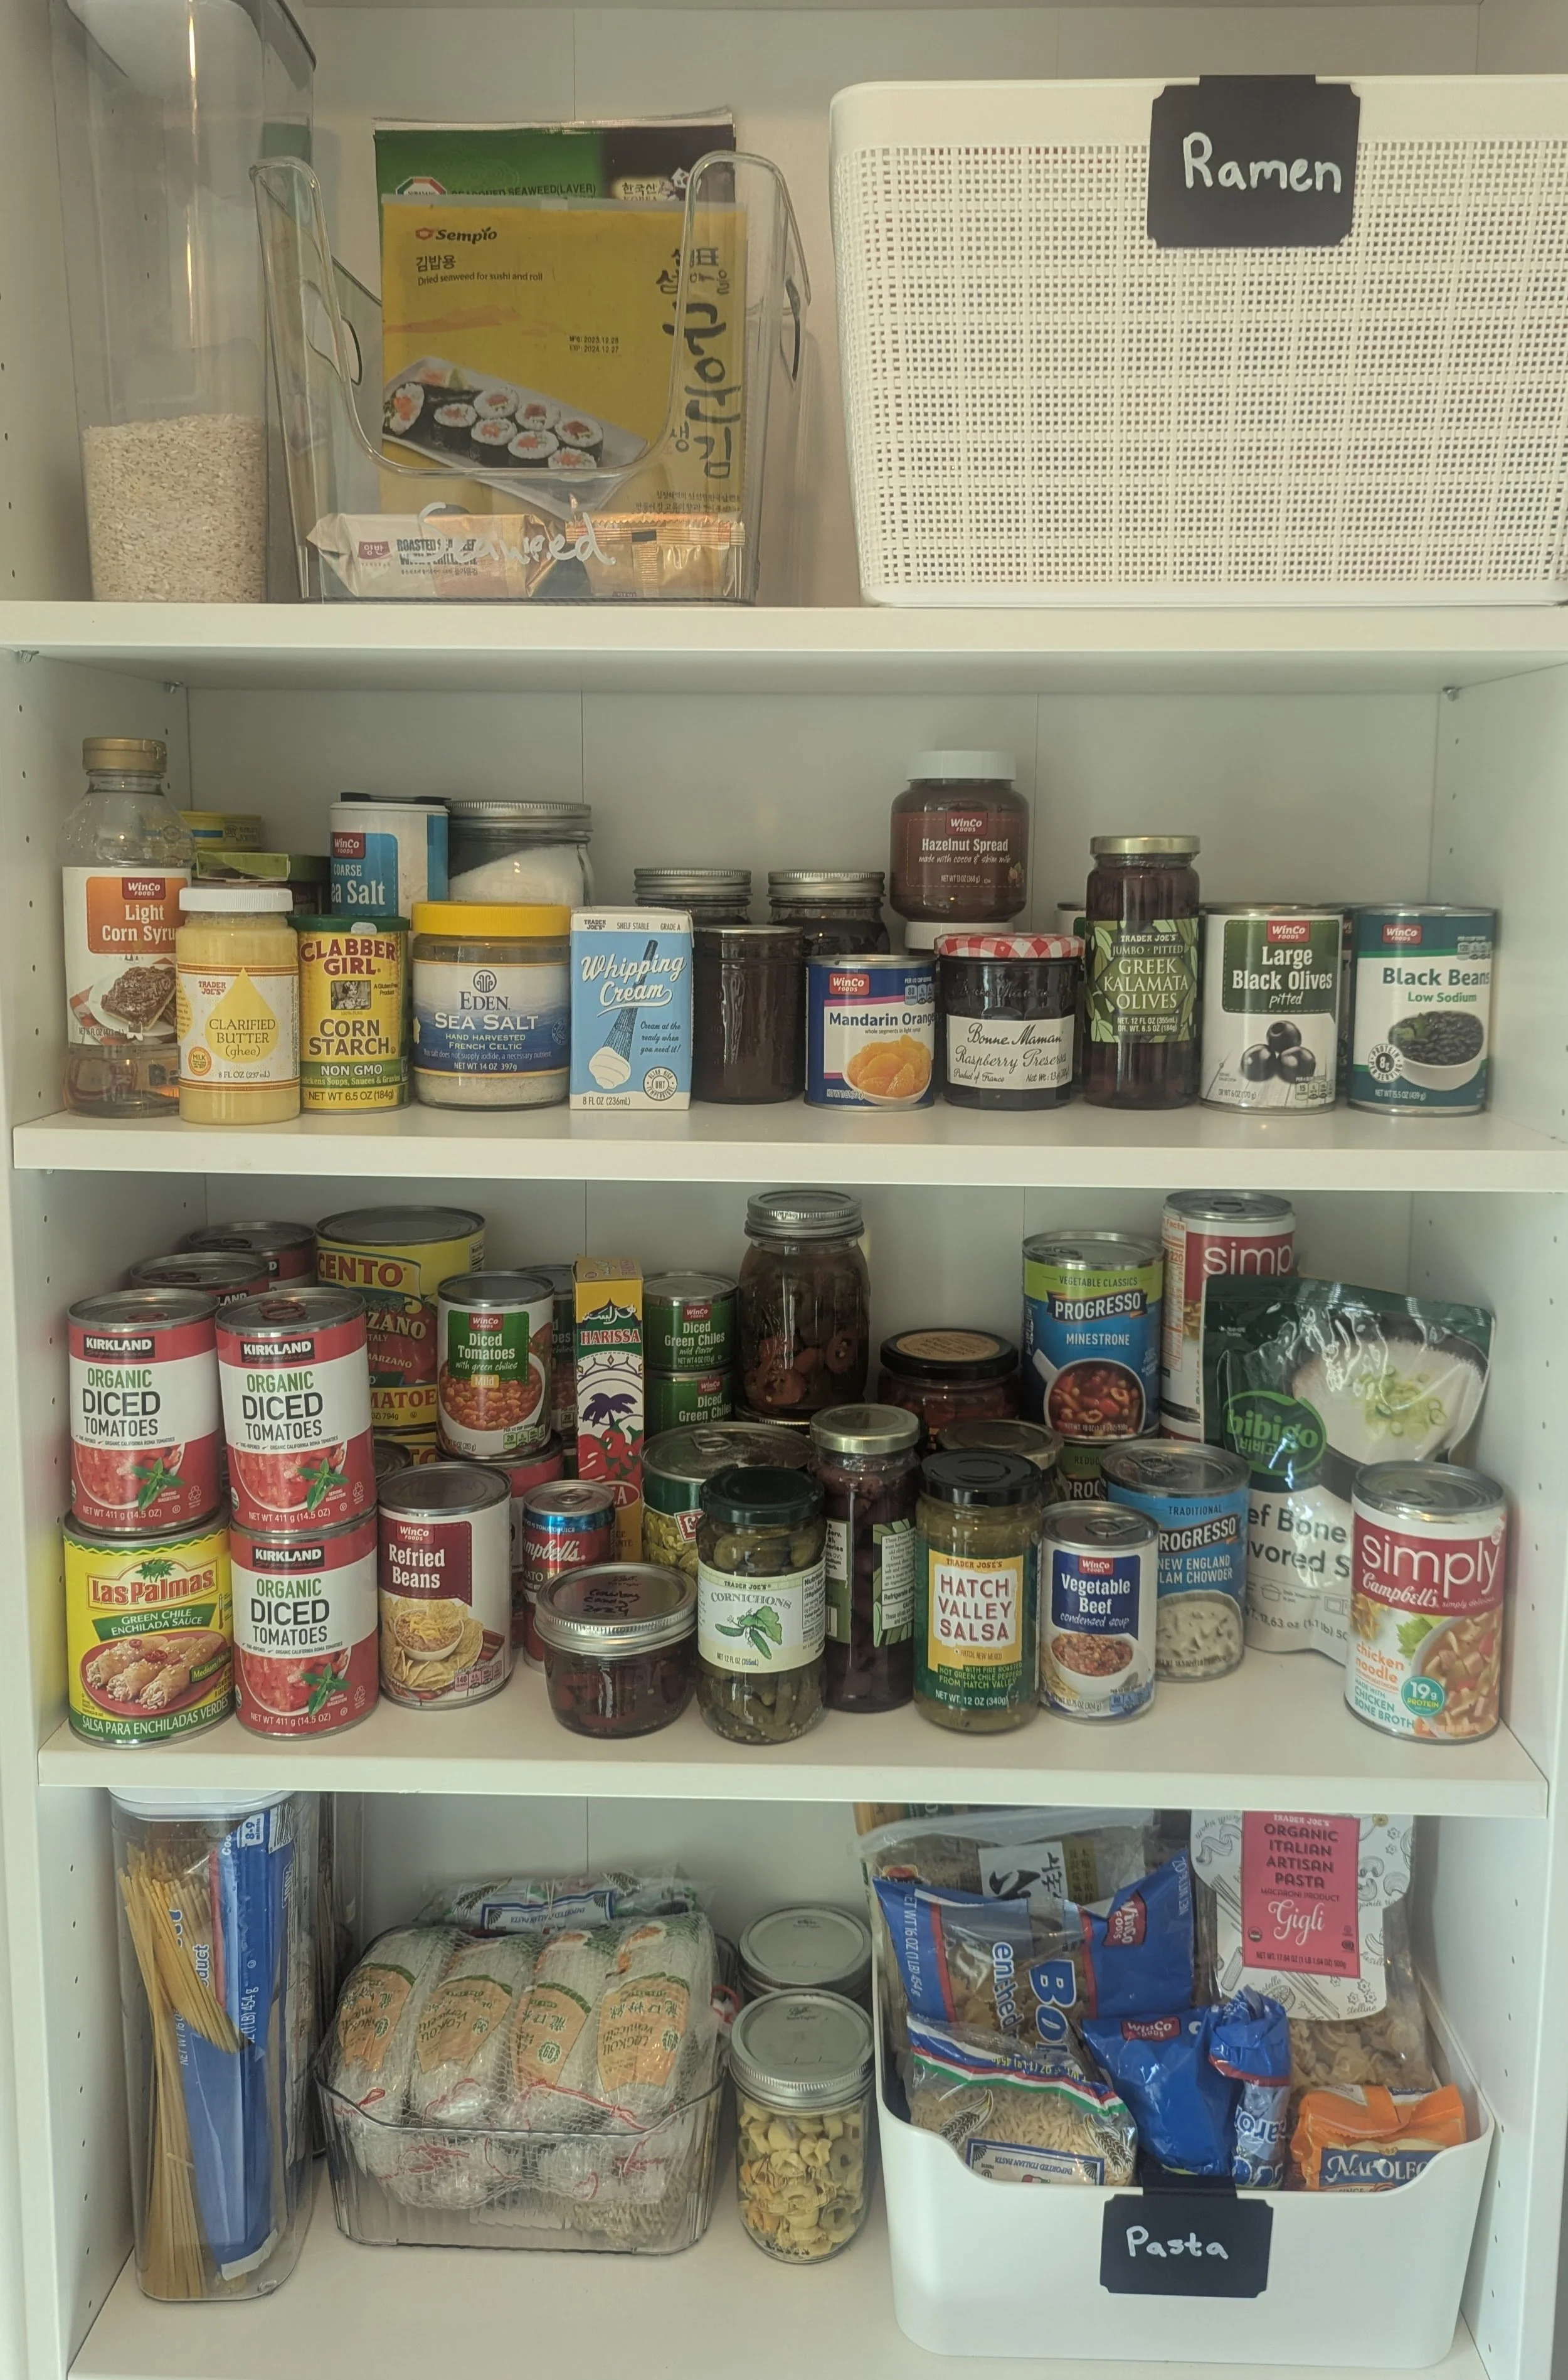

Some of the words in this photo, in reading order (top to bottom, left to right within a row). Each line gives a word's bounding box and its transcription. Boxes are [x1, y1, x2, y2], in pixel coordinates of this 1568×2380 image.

[1183, 132, 1342, 193] Ramen
[436, 227, 497, 244] Sempio
[416, 255, 457, 272] 김밥용
[418, 275, 438, 286] Dried
[441, 272, 475, 282] seaweed
[477, 272, 488, 280] for
[490, 272, 511, 280] sushi
[512, 272, 528, 280] and
[530, 272, 543, 281] roll
[950, 818, 982, 827] WinCo
[334, 838, 359, 848] WinCo
[922, 838, 970, 851] Hazelnut
[973, 839, 1009, 853] Spread
[334, 864, 362, 876] COARSE
[128, 882, 161, 891] WinCo
[331, 883, 342, 903] ea
[347, 879, 385, 905] Salt
[125, 905, 164, 924] Light
[102, 925, 137, 941] Corn
[144, 925, 176, 945] Syru
[1271, 925, 1305, 935] WinCo
[1385, 928, 1417, 937] WinCo
[301, 938, 396, 962] CLABBER
[1113, 946, 1145, 955] JUMBO
[1153, 945, 1183, 954] PITTED
[1261, 946, 1312, 969] Large
[324, 957, 376, 975] GIRL
[581, 954, 687, 984] Whipping
[1118, 958, 1177, 975] GREEK
[198, 980, 226, 989] TRADER
[833, 977, 864, 987] WinCo
[1104, 975, 1189, 992] KALAMATA
[1232, 970, 1282, 990] Black
[1288, 970, 1332, 991] Olives
[1382, 967, 1441, 986] Black
[1448, 969, 1490, 986] Beans
[458, 991, 509, 1011] EDEN
[599, 982, 672, 1009] Cream
[1116, 993, 1177, 1009] OLIVES
[1269, 991, 1304, 1009] pitted
[1407, 992, 1433, 1002] Low
[1436, 992, 1477, 1002] Sodium
[209, 1019, 276, 1030] CLARIFIED
[319, 1019, 379, 1038] CORN
[435, 1012, 475, 1030] SEA
[483, 1014, 539, 1030] SALT
[829, 1012, 898, 1027] Mandarin
[902, 1012, 935, 1028] Orange
[216, 1033, 270, 1043] BUTTER
[967, 1022, 1009, 1045] Bonne
[1012, 1024, 1062, 1045] Maman
[225, 1044, 261, 1059] (ghee)
[309, 1037, 389, 1056] STARCH
[449, 1042, 485, 1050] FRENCH
[501, 1063, 517, 1071] 397g
[955, 1045, 1019, 1074] Raspberry
[320, 1065, 351, 1076] NON
[354, 1064, 383, 1076] GMO
[309, 1092, 325, 1100] NET
[328, 1092, 343, 1101] WT
[359, 1092, 373, 1100] OZ
[1203, 1241, 1292, 1276] simp
[319, 1254, 403, 1287] CENTO
[1059, 1275, 1101, 1288] VEGETABLE
[1103, 1277, 1138, 1287] CLASSICS
[1055, 1292, 1141, 1320] PROGRESSO
[683, 1321, 711, 1334] Diced
[86, 1337, 152, 1351] KIRKLAND
[469, 1333, 502, 1346] Diced
[580, 1329, 641, 1346] HARISSA
[664, 1335, 694, 1347] Green
[698, 1332, 725, 1346] Chiles
[1066, 1333, 1130, 1346] MINESTRONE
[243, 1341, 312, 1356] KIRKLAND
[458, 1344, 515, 1360] Tomatoes
[472, 1362, 492, 1373] green
[494, 1361, 518, 1371] chilies
[88, 1367, 152, 1388] ORGANIC
[246, 1371, 314, 1393] ORGANIC
[474, 1376, 494, 1386] Mild
[82, 1387, 161, 1417] DICED
[242, 1391, 323, 1421] DICED
[697, 1393, 722, 1408] Diced
[679, 1410, 708, 1422] Green
[83, 1416, 158, 1437] TOMATOES
[245, 1419, 322, 1442] TOMATOES
[1226, 1410, 1318, 1450] bibigo
[1169, 1504, 1222, 1516] TRADITIONAL
[400, 1526, 429, 1537] WinCo
[1160, 1517, 1236, 1551] ROGRESSO
[1277, 1507, 1346, 1544] Bone
[255, 1548, 322, 1562] KIRKLAND
[389, 1543, 445, 1567] Refried
[946, 1558, 974, 1568] TRADER
[1186, 1554, 1230, 1570] ENGLAND
[1082, 1560, 1110, 1569] WinCo
[1362, 1534, 1500, 1599] simply
[392, 1566, 440, 1588] Beans
[724, 1580, 746, 1589] TRADER
[1061, 1573, 1130, 1596] Vegetable
[1187, 1568, 1232, 1584] CHOWDER
[92, 1580, 129, 1605] Las
[130, 1570, 215, 1605] Palmas
[257, 1578, 322, 1598] ORGANIC
[940, 1573, 1009, 1598] HATCH
[1362, 1569, 1436, 1607] Campbell's
[711, 1591, 792, 1610] CORNICHONS
[938, 1595, 1012, 1620] VALLEY
[1079, 1596, 1112, 1614] Beef
[121, 1613, 158, 1625] GREEN
[161, 1608, 193, 1619] CHILE
[251, 1598, 330, 1626] DICED
[111, 1620, 169, 1636] ENCHILADA
[171, 1617, 202, 1627] SAUCE
[1060, 1613, 1106, 1627] condensed
[1109, 1617, 1129, 1629] soup
[252, 1625, 327, 1646] TOMATOES
[940, 1618, 1009, 1642] SALSA
[1356, 1641, 1404, 1671] chicken
[1356, 1656, 1398, 1683] noodle
[1410, 1681, 1437, 1701] 19g
[1355, 1687, 1395, 1713] CHICKEN
[1407, 1697, 1439, 1708] PROTEIN
[82, 1716, 103, 1733] SALSA
[105, 1721, 131, 1736] PARA
[134, 1711, 198, 1735] ENCHILADAS
[200, 1695, 228, 1719] VERDES
[1355, 1698, 1376, 1716] BONE
[1378, 1707, 1414, 1728] BROTH
[1264, 1823, 1339, 1842] ORGANIC
[1269, 1839, 1332, 1856] ITALIAN
[1266, 1856, 1334, 1873] ARTISAN
[1275, 1872, 1325, 1889] PASTA
[1261, 1887, 1301, 1899] MACARONI
[1304, 1891, 1340, 1902] PRODUCT
[1268, 1899, 1325, 1946] Gigli
[995, 2156, 1014, 2166] PASTA
[1014, 2160, 1038, 2169] ITALIAN
[1126, 2226, 1229, 2260] Pasta
